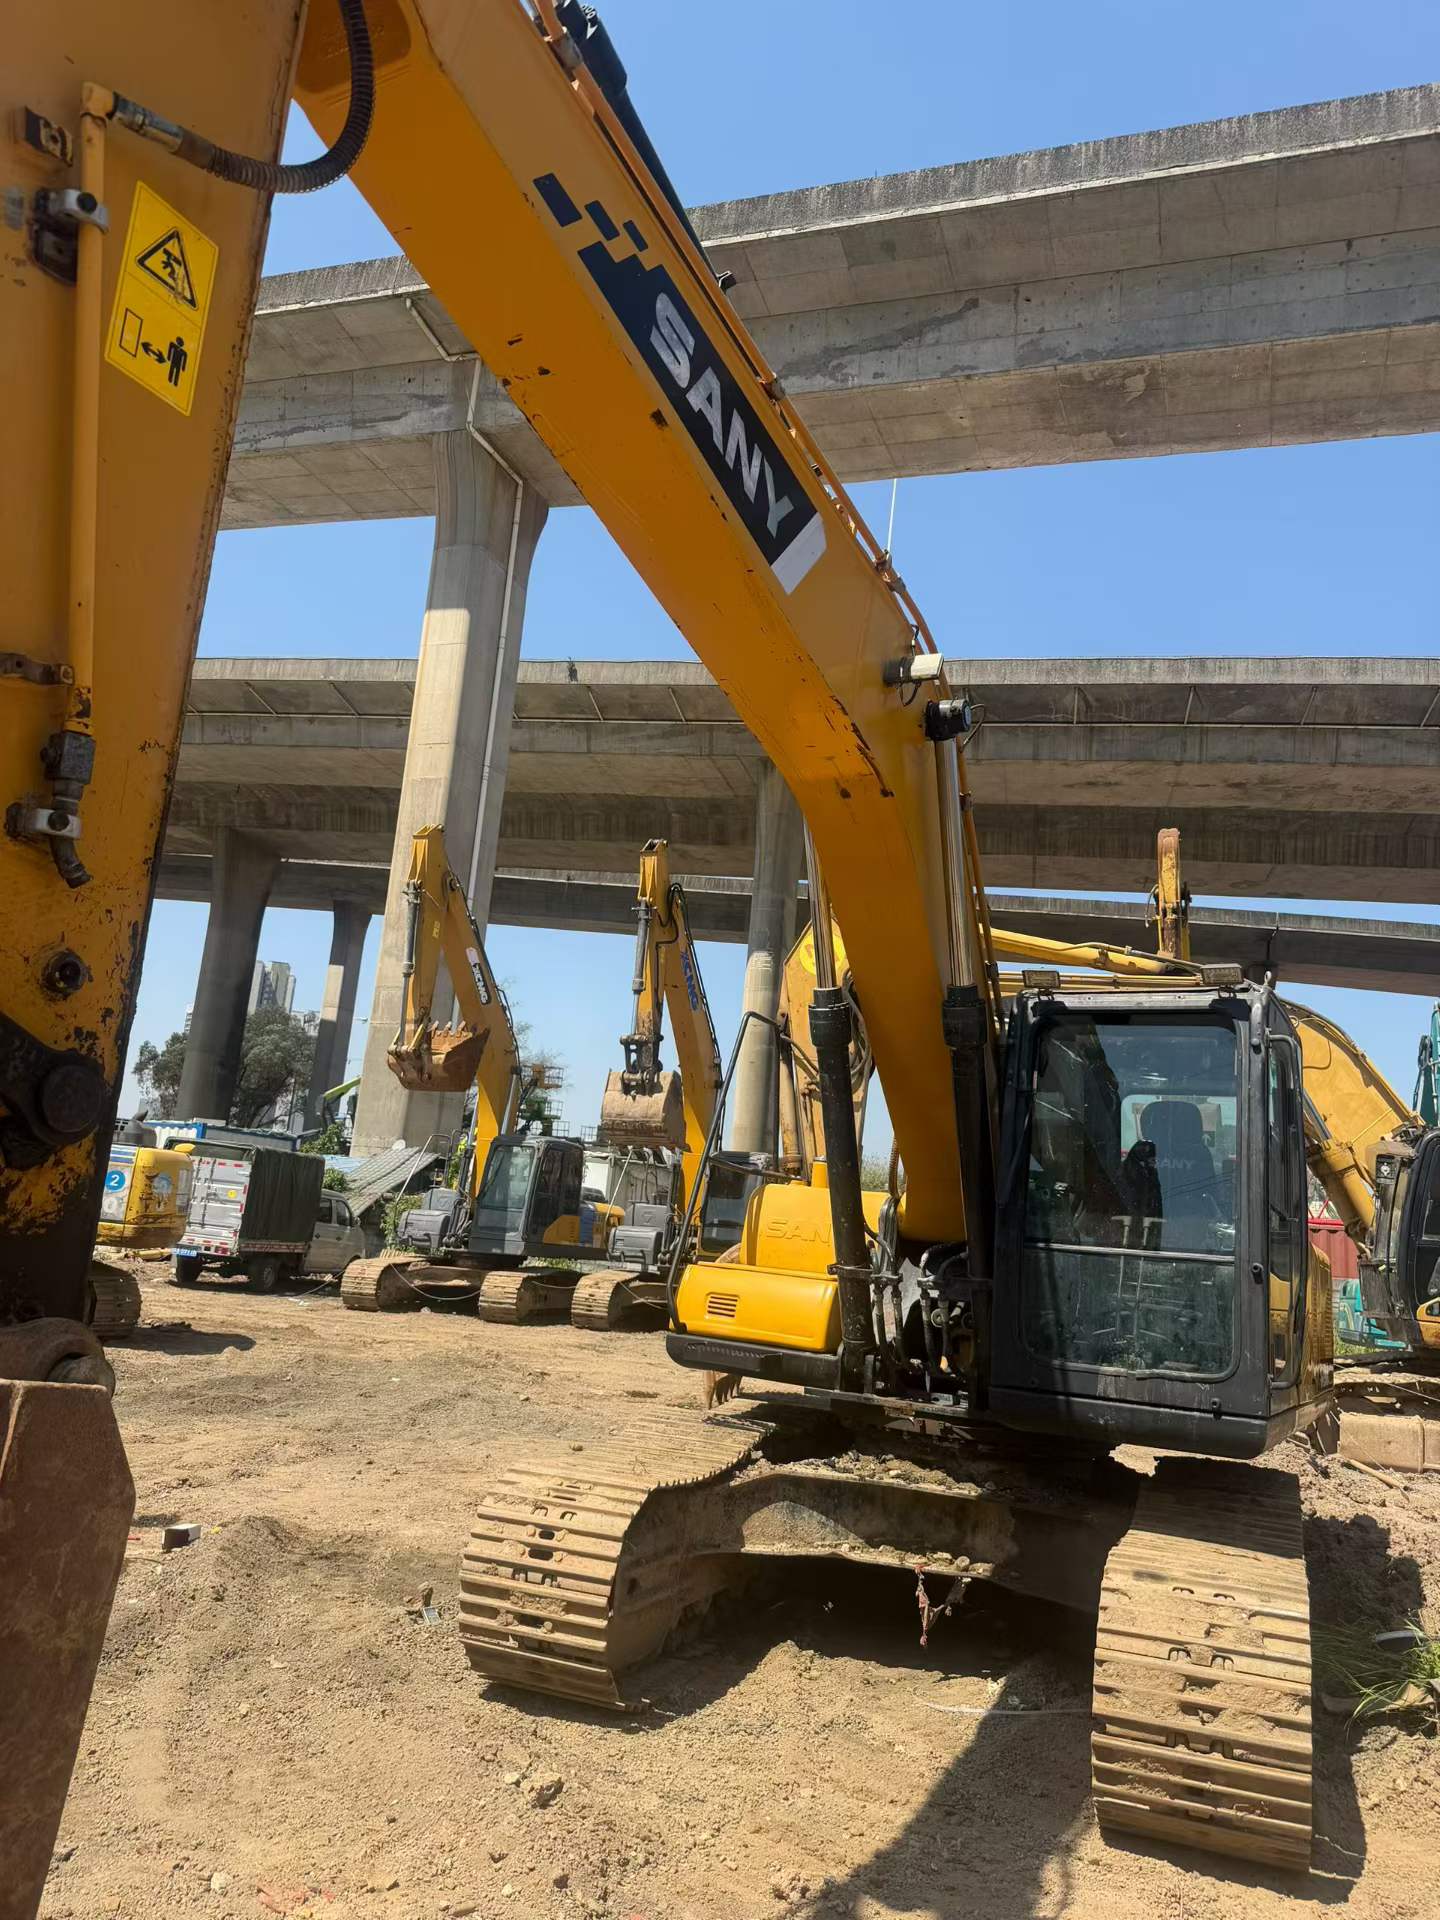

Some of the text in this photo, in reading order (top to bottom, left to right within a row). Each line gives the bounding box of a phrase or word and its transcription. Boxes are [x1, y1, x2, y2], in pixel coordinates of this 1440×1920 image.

[650, 292, 794, 539] SANY
[109, 1174, 120, 1187] 2
[766, 1217, 832, 1245] SAN
